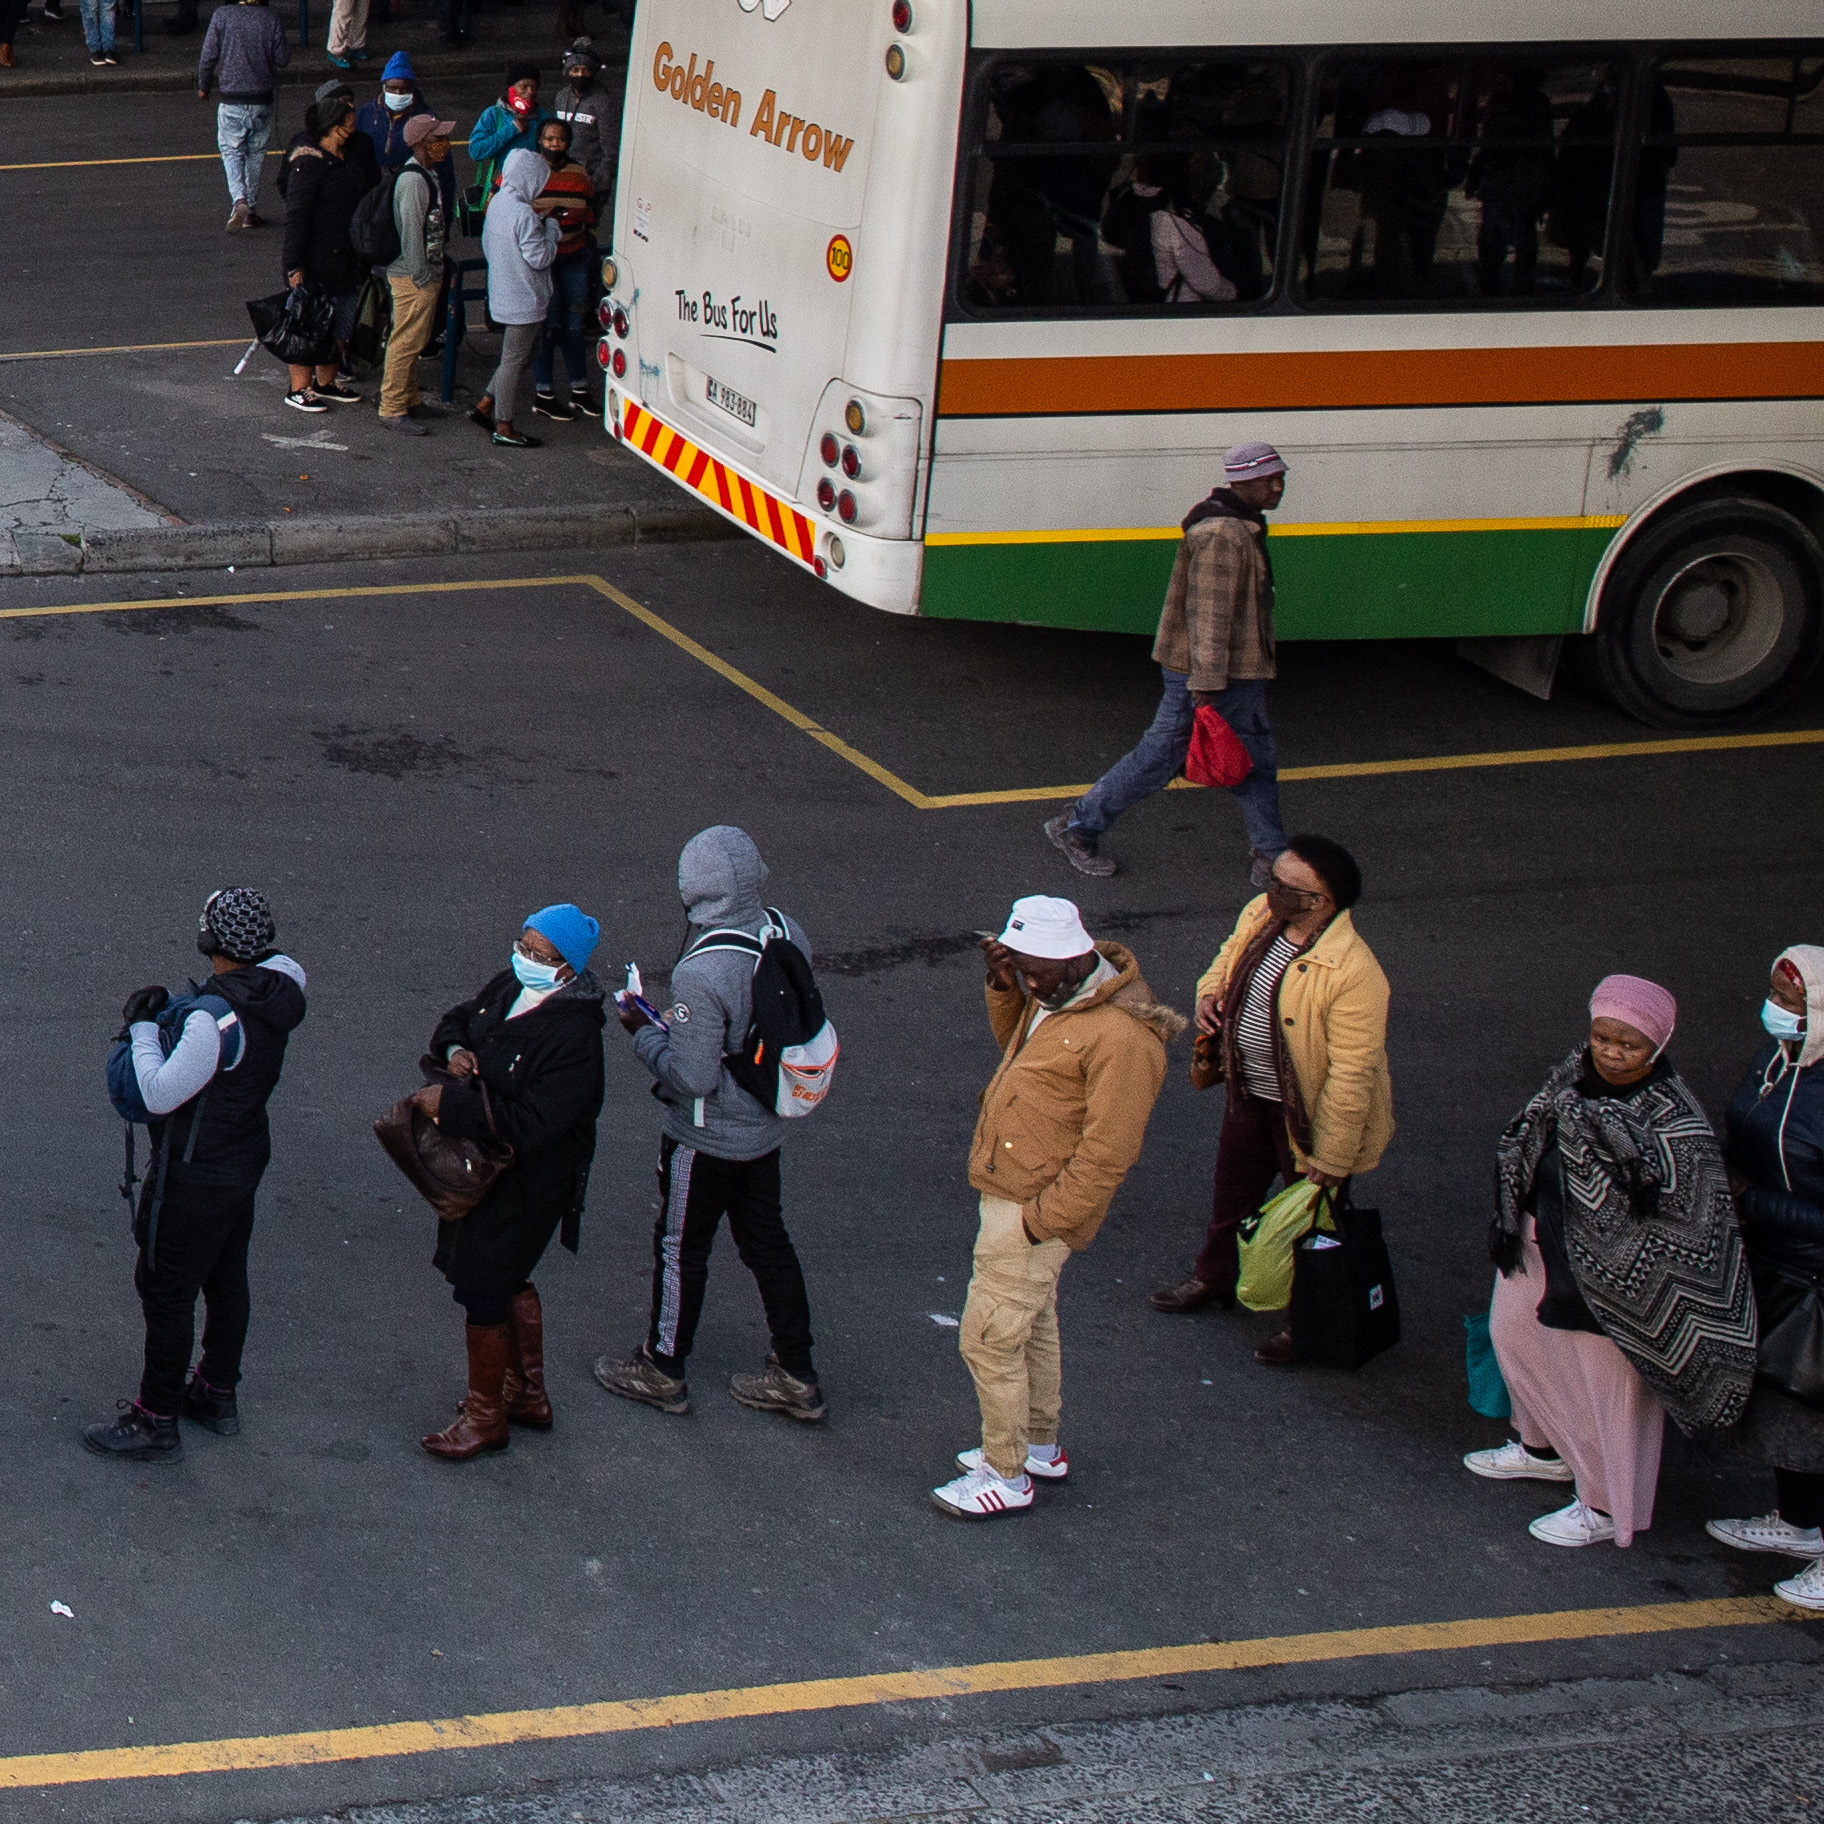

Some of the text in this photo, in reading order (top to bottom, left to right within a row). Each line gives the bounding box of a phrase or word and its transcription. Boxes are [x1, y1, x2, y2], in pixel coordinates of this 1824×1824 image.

[653, 41, 854, 173] Golden Arrow
[831, 247, 850, 270] 100
[675, 289, 778, 339] The Bus For Us
[707, 376, 718, 401] CA
